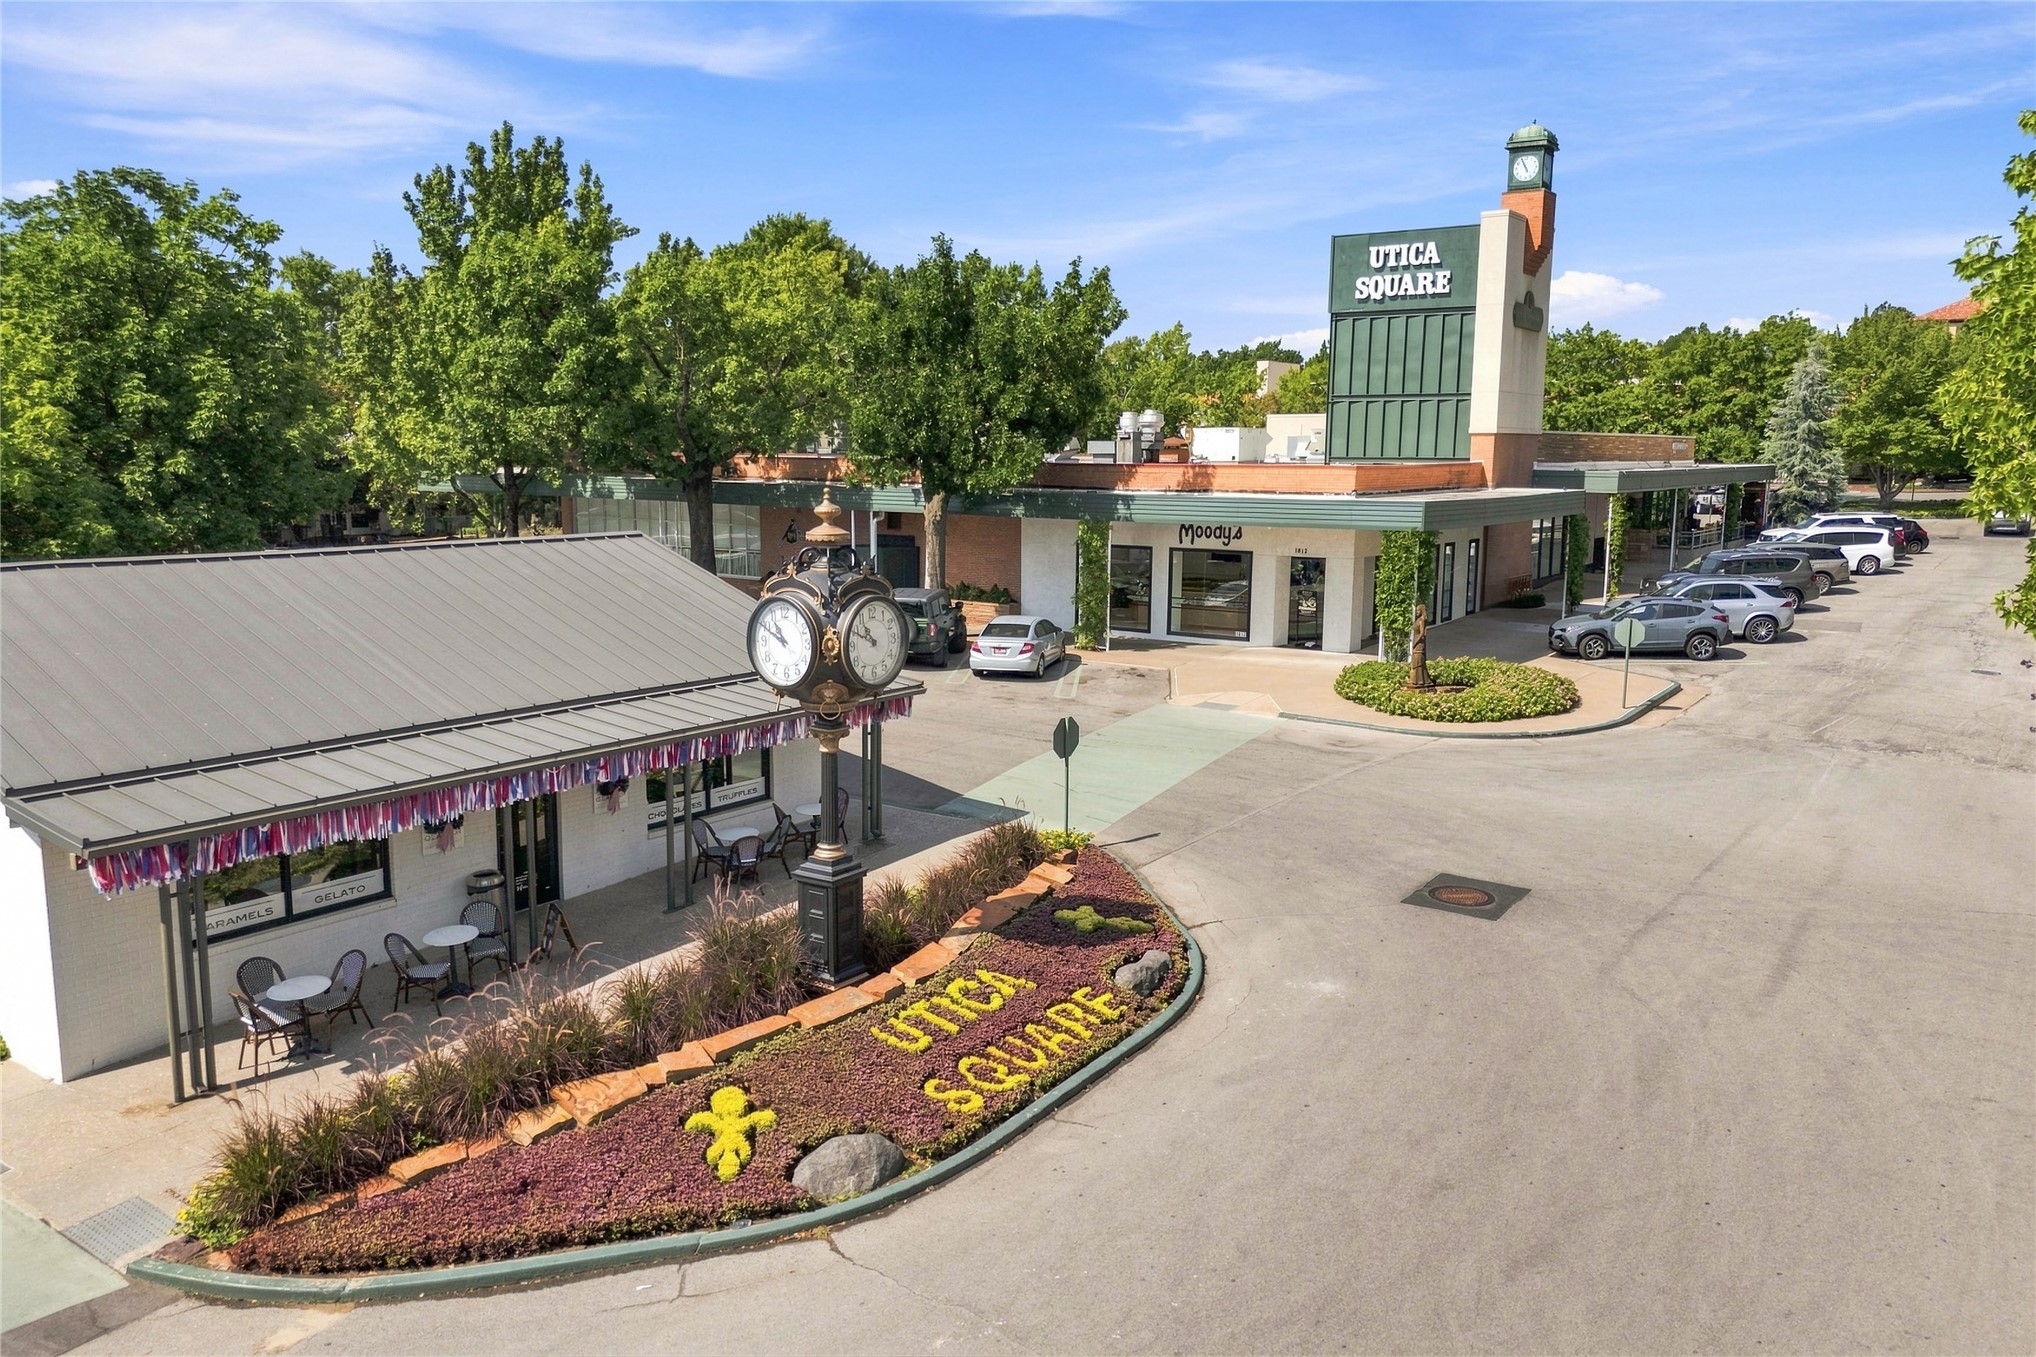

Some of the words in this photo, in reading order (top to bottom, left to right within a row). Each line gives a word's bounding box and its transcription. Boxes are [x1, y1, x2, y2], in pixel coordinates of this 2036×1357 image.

[1369, 241, 1441, 269] UTICA
[1355, 270, 1452, 301] SQUARE
[1179, 523, 1243, 546] Moody's
[781, 606, 789, 619] 12
[868, 606, 876, 619] 12
[761, 635, 767, 647] 9
[804, 638, 811, 651] 3
[890, 632, 897, 644] 3
[849, 641, 855, 652] 9
[764, 650, 771, 663] 8
[853, 656, 859, 667] 8
[783, 666, 790, 679] 6
[871, 665, 877, 678] 6
[717, 787, 758, 802] TRUFFLES
[314, 884, 366, 904] GELATO
[207, 907, 274, 930] ARAMELS
[870, 969, 1037, 1053] UTICA
[924, 986, 1128, 1114] SQUARE
